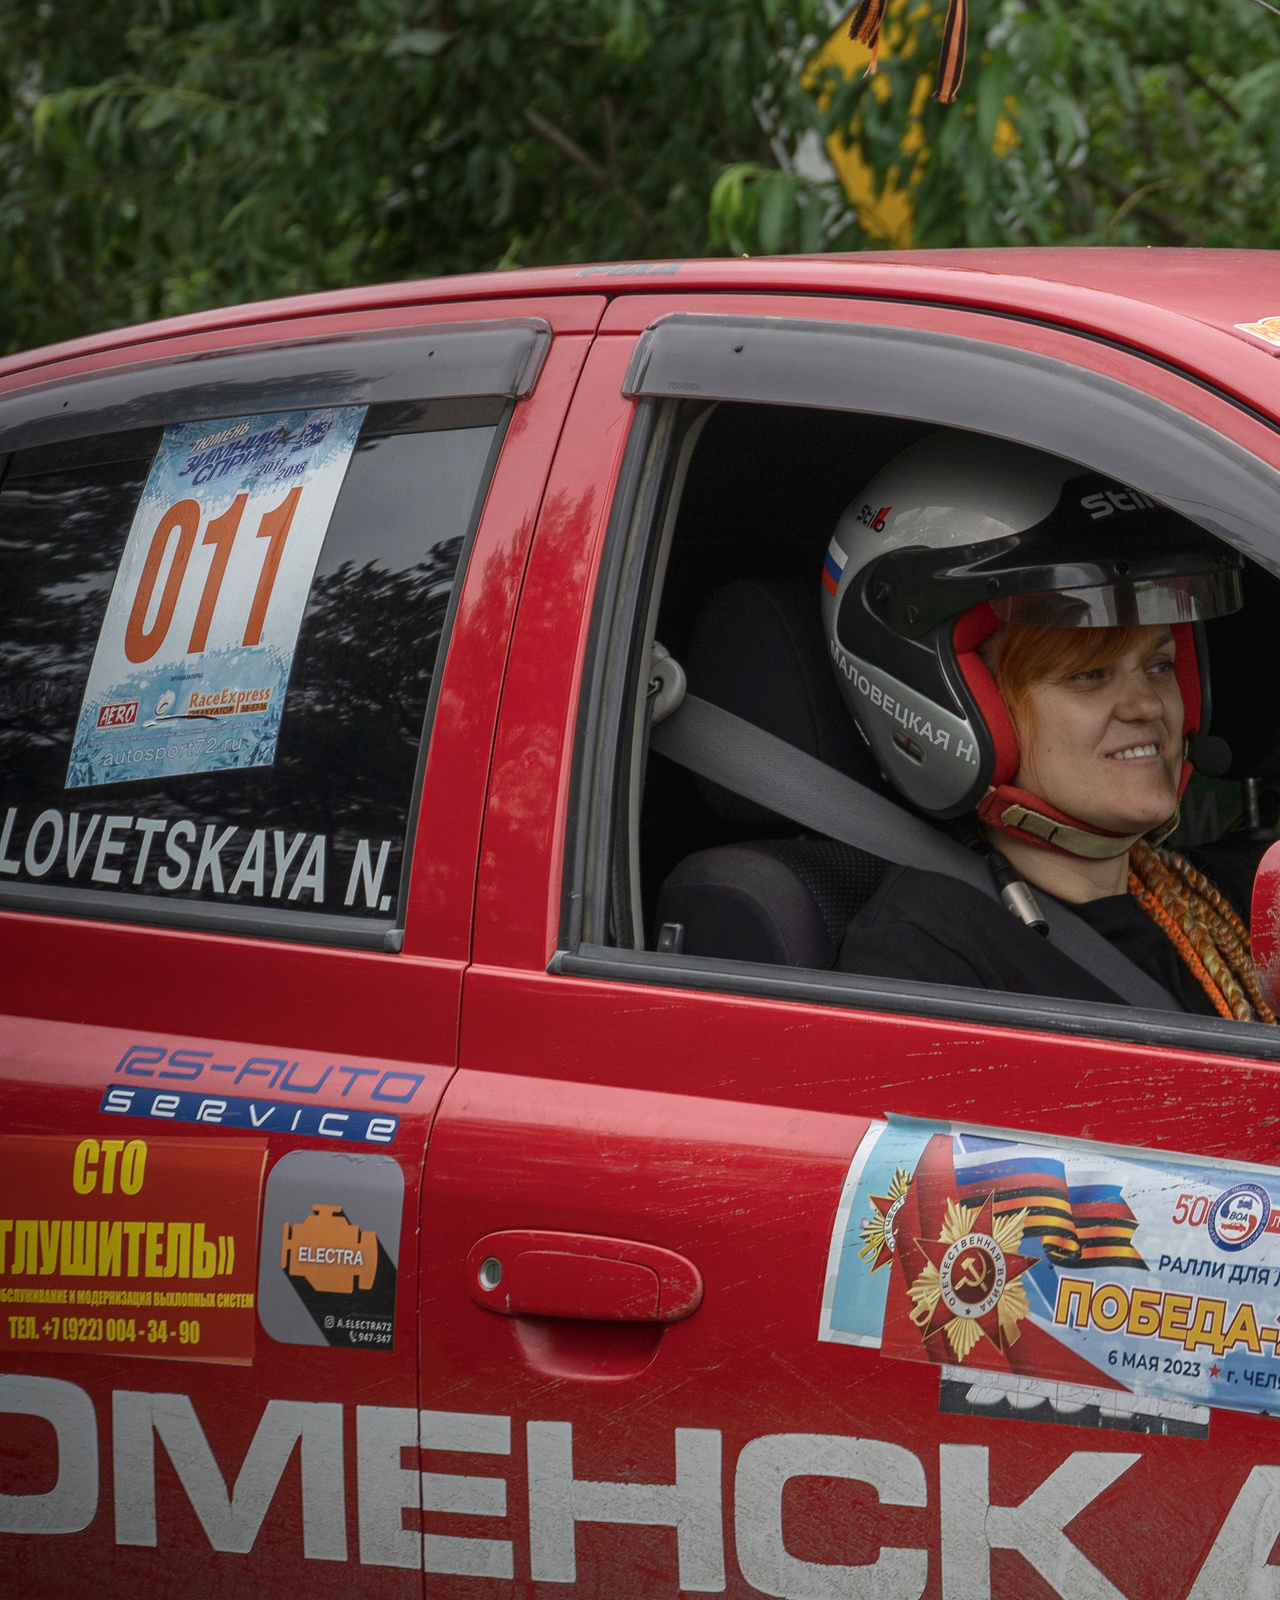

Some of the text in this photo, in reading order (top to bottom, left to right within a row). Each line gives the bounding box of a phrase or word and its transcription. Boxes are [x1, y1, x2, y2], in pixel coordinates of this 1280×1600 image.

[189, 422, 251, 453] ТЮМЕНЬ
[255, 458, 288, 477] 2017
[274, 461, 309, 482] 2018
[856, 503, 893, 534] Stilo
[1080, 488, 1156, 520] Stil
[124, 485, 304, 664] 011
[99, 703, 137, 726] AERO
[188, 687, 272, 714] RaceExpress
[829, 638, 979, 766] МАЛОВЕЦКАЯ Н.
[103, 736, 243, 767] autosport72.ru
[0, 807, 392, 912] LOVETSKAYA N.
[115, 1045, 426, 1104] RS-AUTO
[72, 1138, 148, 1196] СТО
[1228, 1211, 1249, 1223] ВОА
[297, 1246, 364, 1267] ELECTRA
[941, 1236, 1002, 1307] ОТЕЧЕСТВЕННАЯ
[1159, 1253, 1222, 1281] РАЛЛИ
[1227, 1262, 1271, 1291] ДЛЯ
[0, 1287, 254, 1309] БСЛУЖИВАНИЕ И МОДЕРНИЗАЦИЯ ВЫХЛОПНЫХ СИСТЕМ
[8, 1316, 40, 1340] ТЕЛ.
[42, 1317, 61, 1340] +7
[63, 1317, 103, 1341] (922)
[106, 1318, 136, 1343] 004
[148, 1319, 167, 1344] 34
[179, 1320, 200, 1344] 90
[336, 1318, 393, 1332] A.ELECTRA72
[358, 1332, 392, 1344] 947-347
[1107, 1350, 1118, 1365] 6
[1121, 1352, 1160, 1372] МАЯ
[1162, 1357, 1202, 1378] 2023
